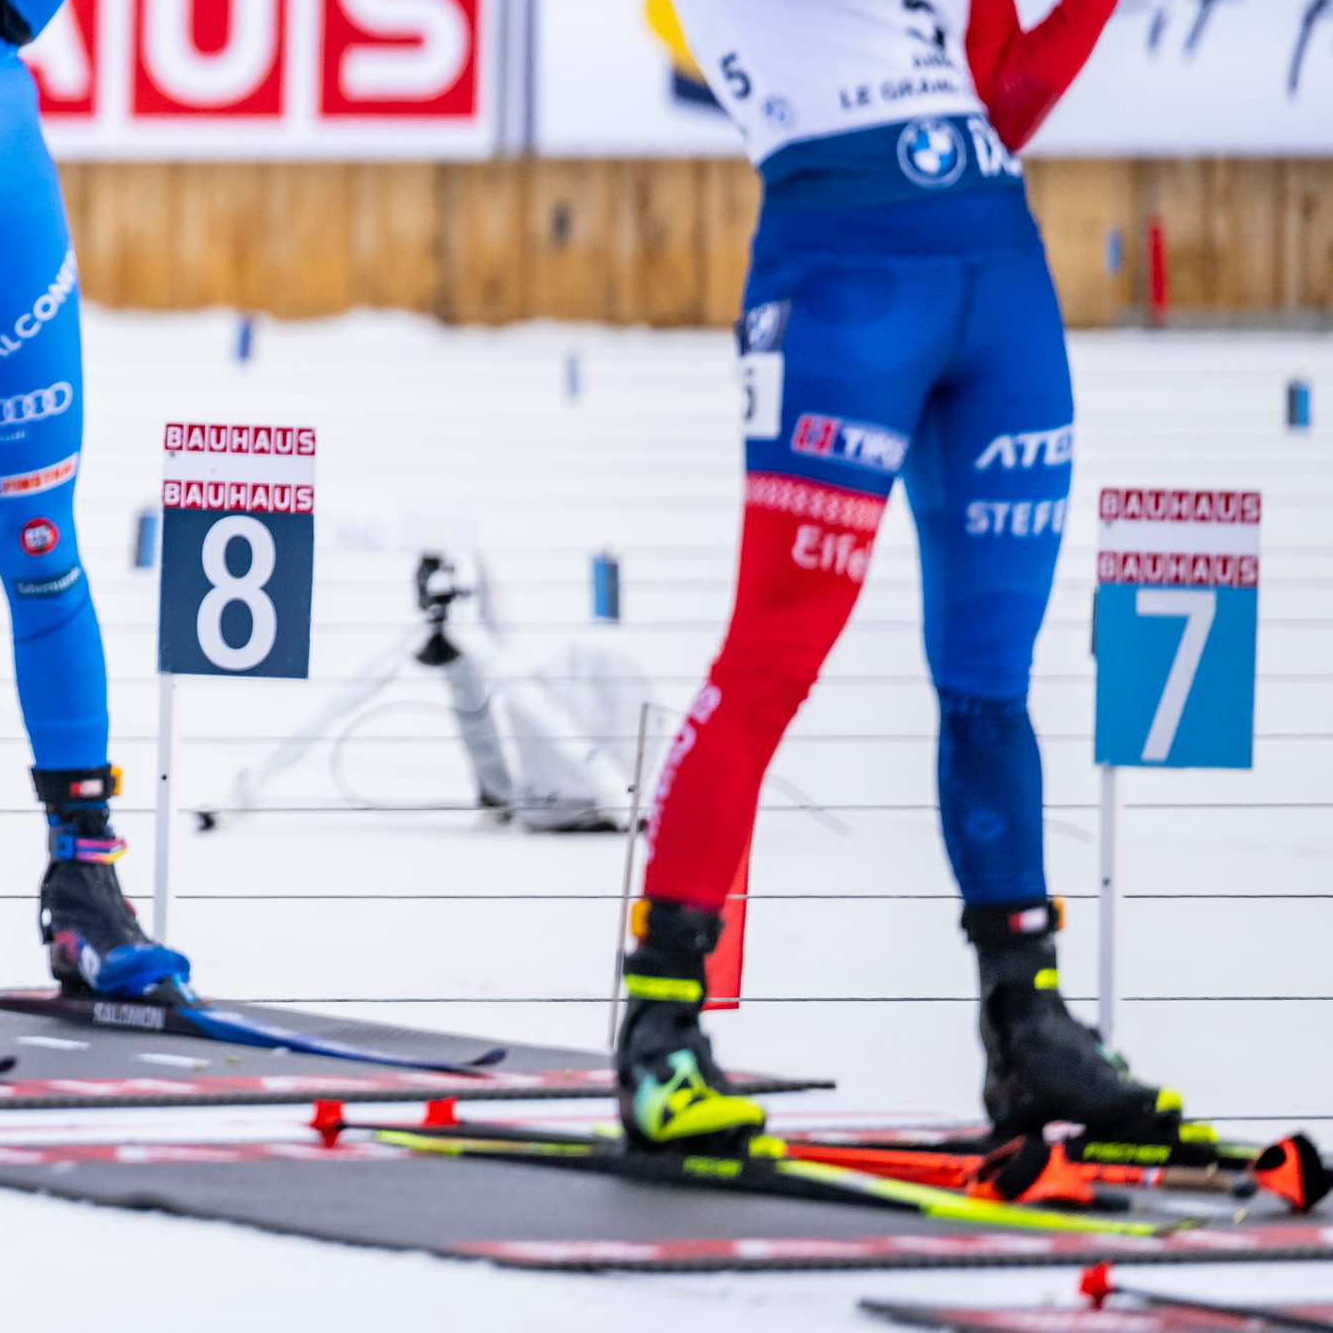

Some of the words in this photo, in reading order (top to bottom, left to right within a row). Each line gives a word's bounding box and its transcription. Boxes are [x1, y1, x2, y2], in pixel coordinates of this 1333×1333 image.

[720, 51, 752, 101] 5
[166, 425, 316, 454] BAUHAUS
[164, 481, 314, 510] BAUHAUS
[1101, 489, 1261, 523] BAUHAUS
[1098, 552, 1259, 586] BAUHAUS
[196, 514, 278, 672] 8
[1135, 588, 1218, 763] 7
